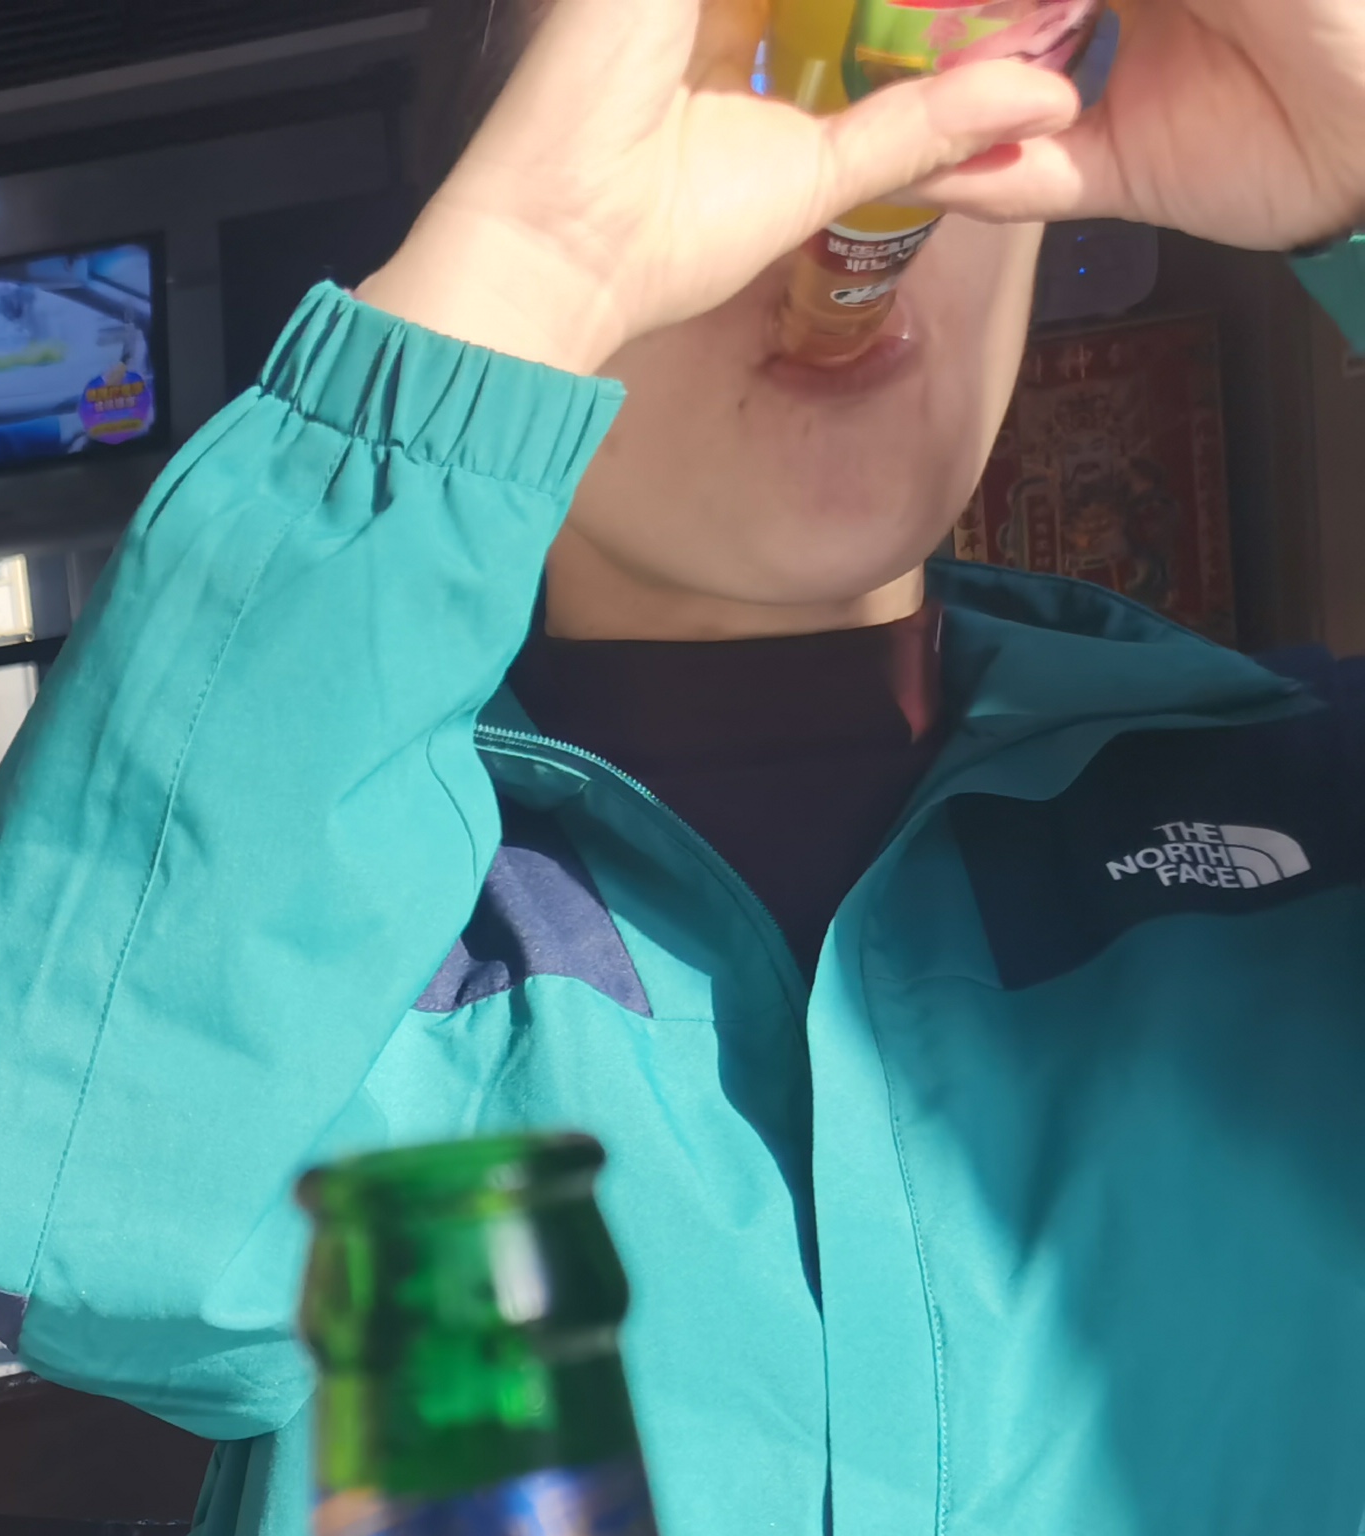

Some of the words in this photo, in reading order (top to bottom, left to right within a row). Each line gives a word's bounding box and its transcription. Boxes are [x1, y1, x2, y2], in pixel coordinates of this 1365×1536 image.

[1153, 821, 1222, 843] THE
[1105, 842, 1231, 881] NORTH
[1156, 862, 1241, 888] FACE
